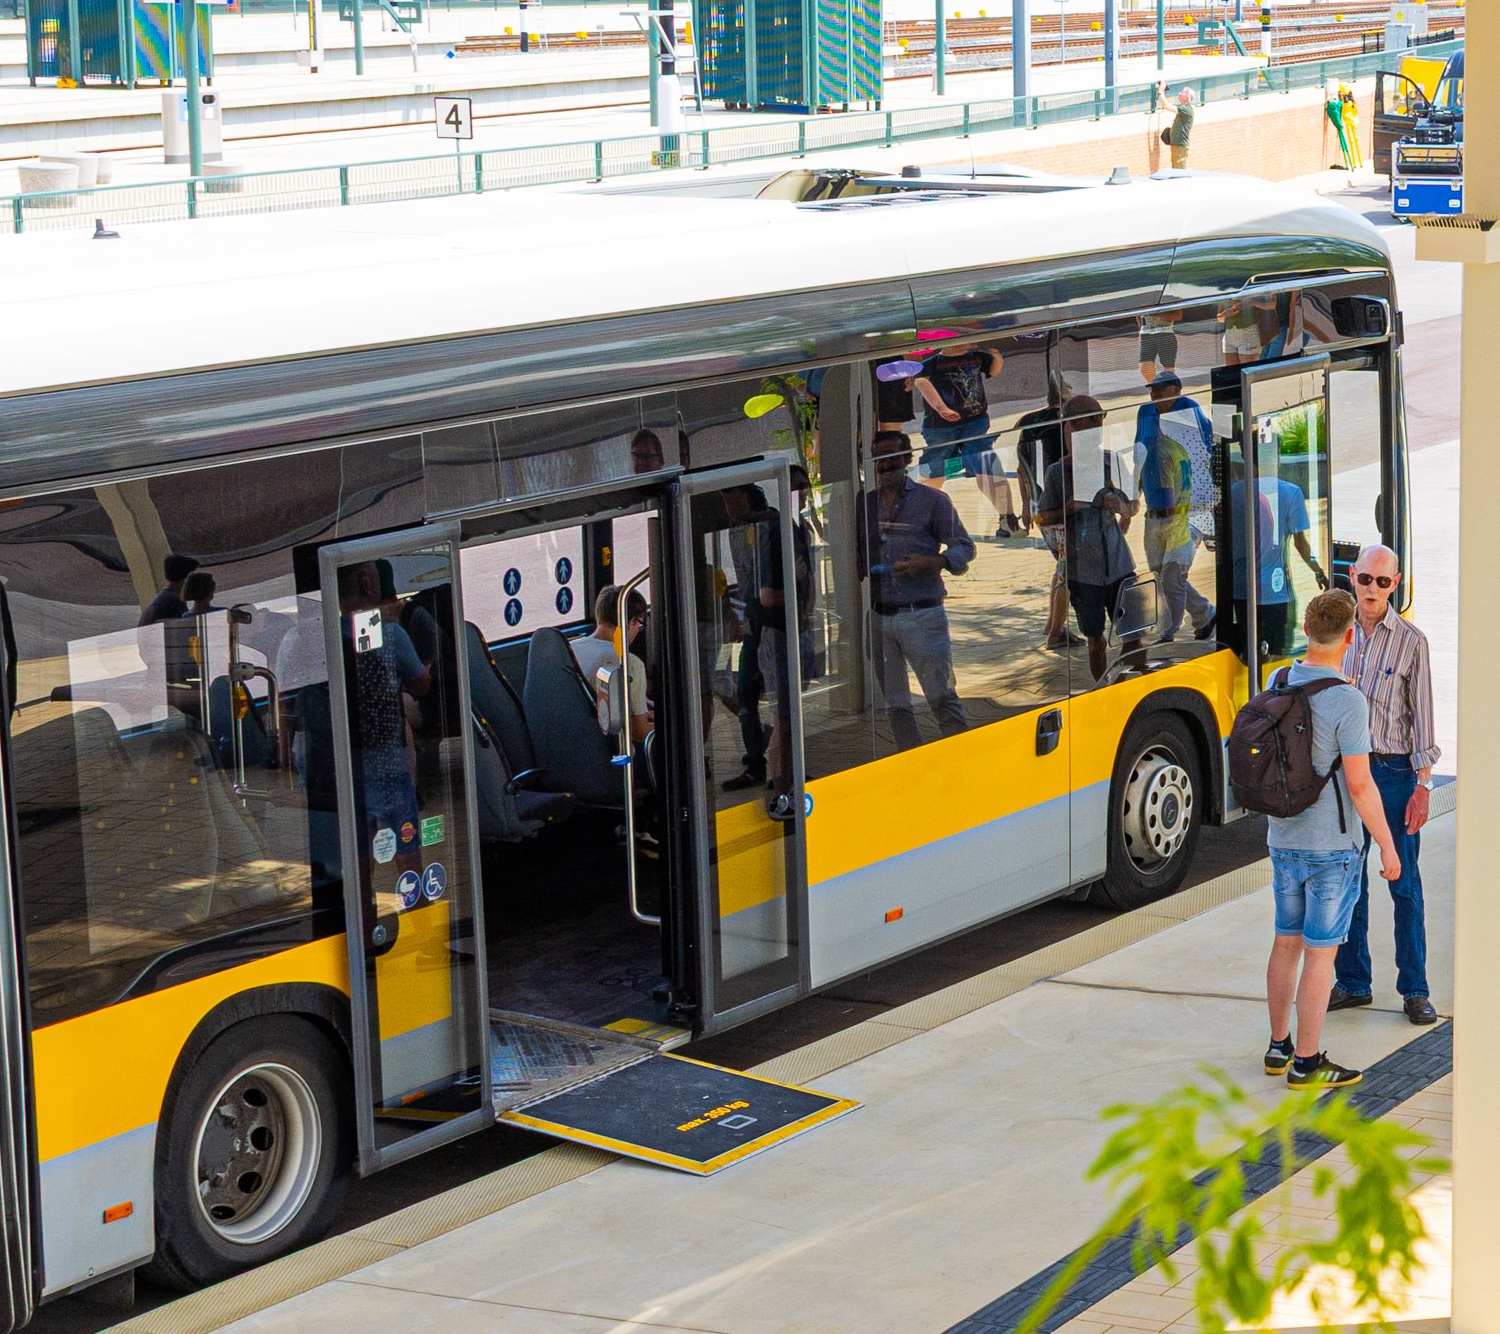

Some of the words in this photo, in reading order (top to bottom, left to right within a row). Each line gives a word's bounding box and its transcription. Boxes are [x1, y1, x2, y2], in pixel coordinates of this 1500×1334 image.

[444, 103, 463, 134] 4
[703, 1106, 732, 1120] 350
[724, 1099, 750, 1111] kg
